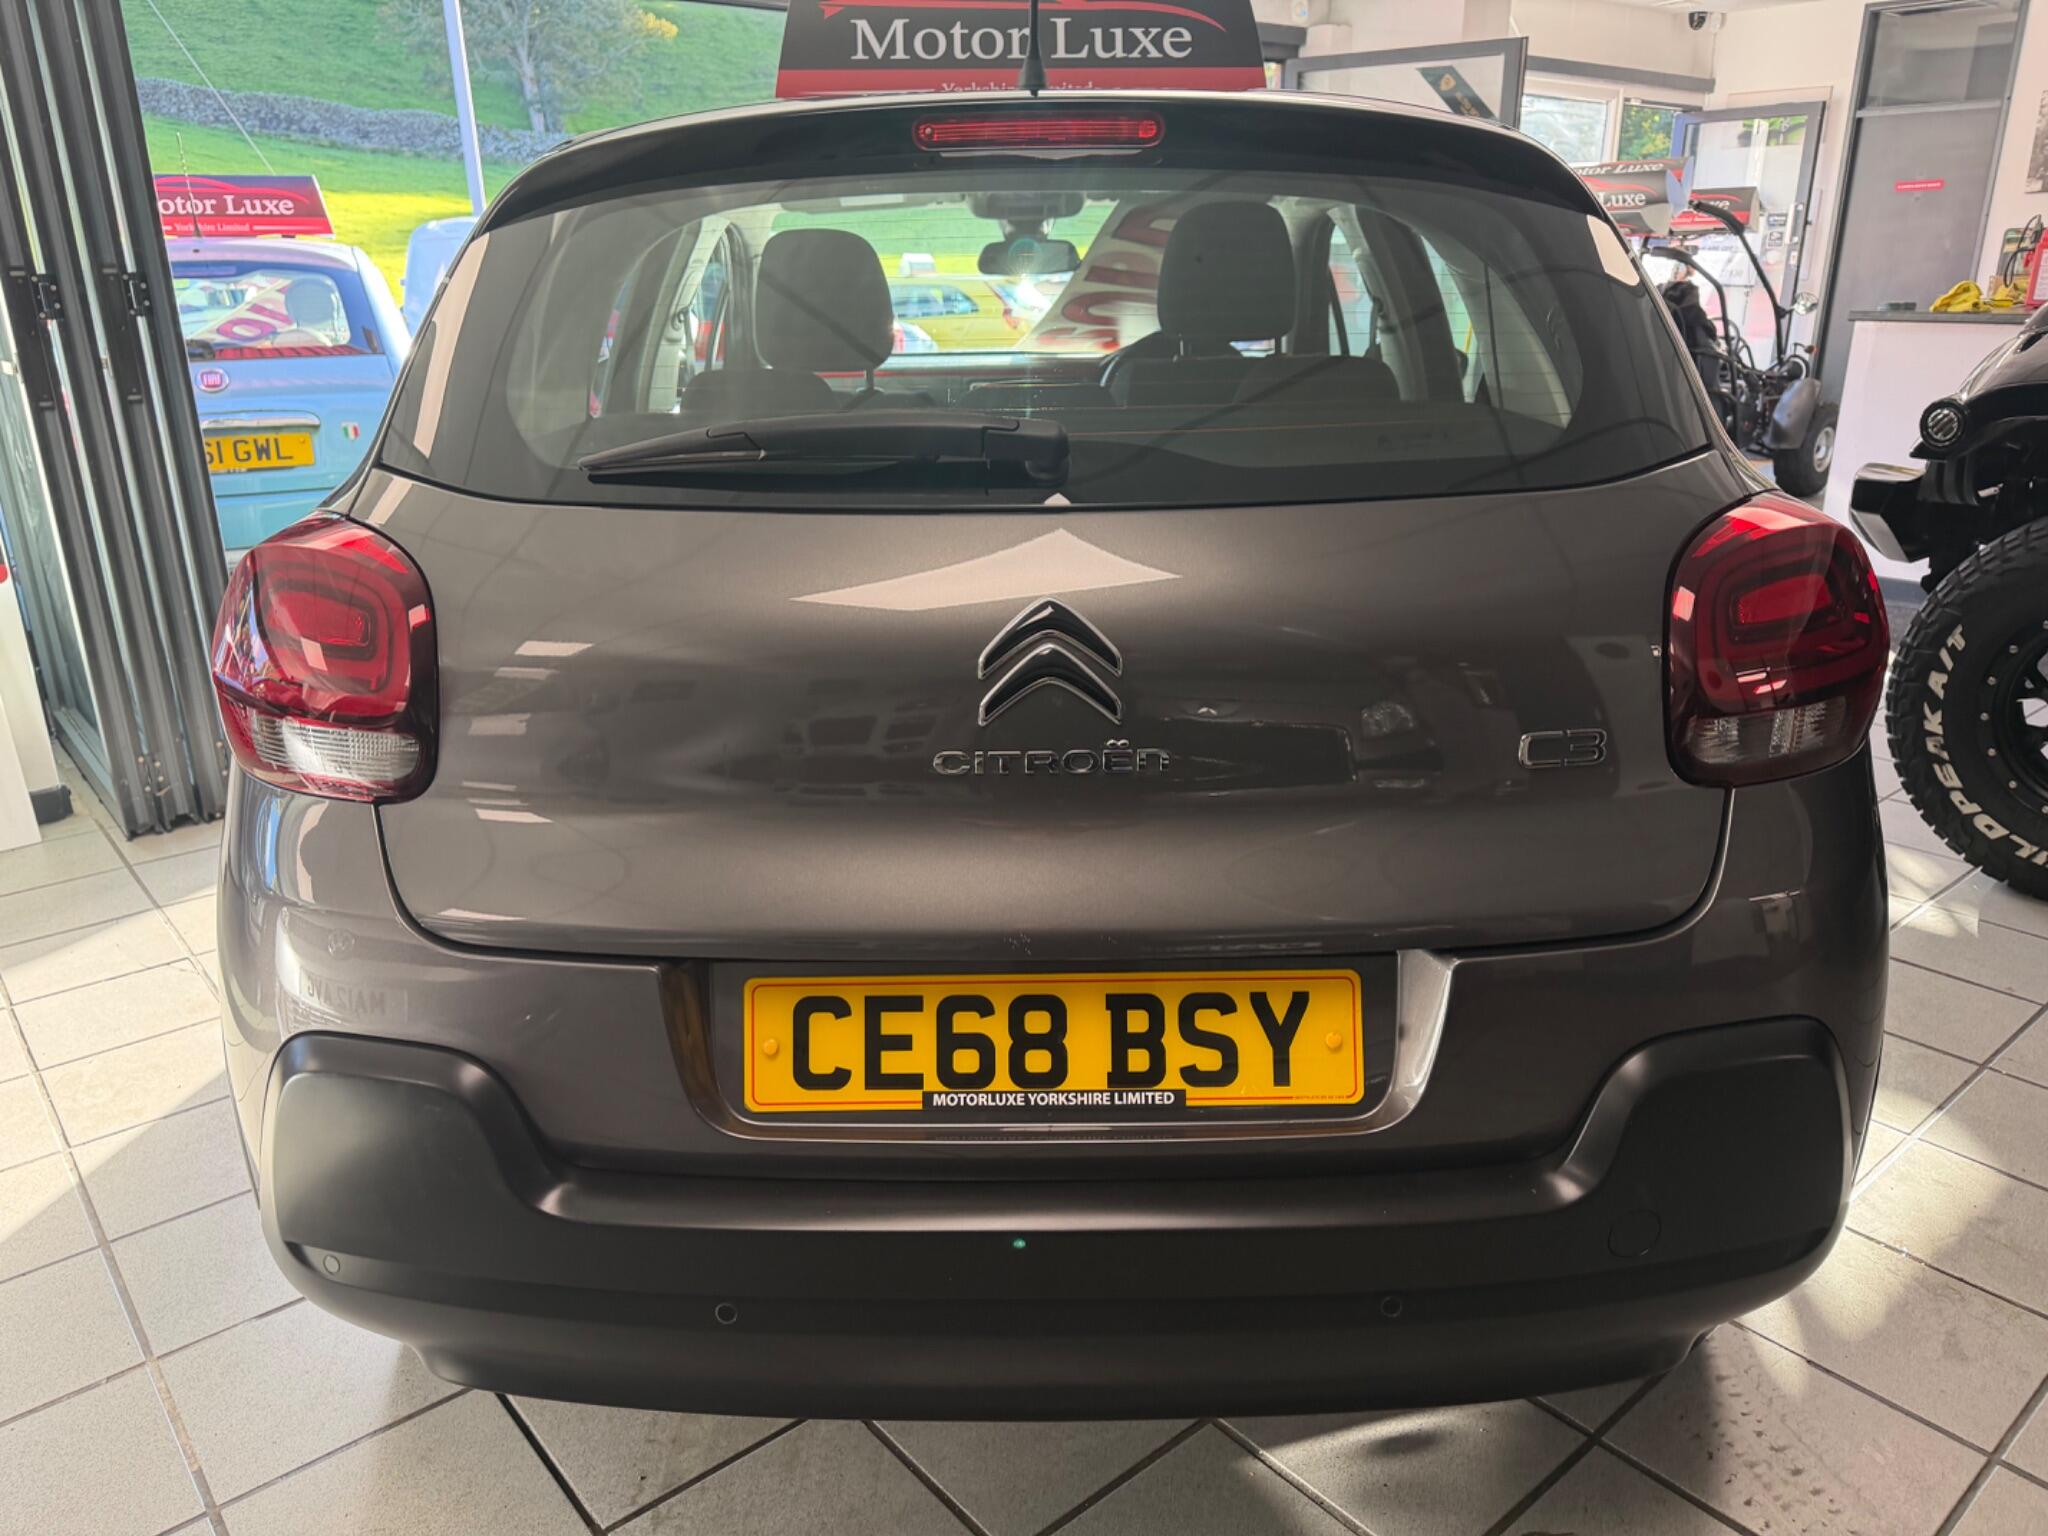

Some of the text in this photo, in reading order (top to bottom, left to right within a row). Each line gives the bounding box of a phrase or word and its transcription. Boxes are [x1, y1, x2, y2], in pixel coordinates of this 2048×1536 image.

[850, 17, 1193, 61] Motor Luxe
[1576, 162, 1664, 175] otor Luxe
[158, 194, 295, 215] otor Luxe
[1599, 191, 1647, 207] Luxe
[232, 437, 294, 463] GWL
[1518, 728, 1607, 770] C3
[1923, 702, 2048, 867] ILDPEAK
[792, 991, 1310, 1092] CE68 BSY
[932, 1091, 1175, 1108] MOTORLUXE YORKSHIRE LIMITED
